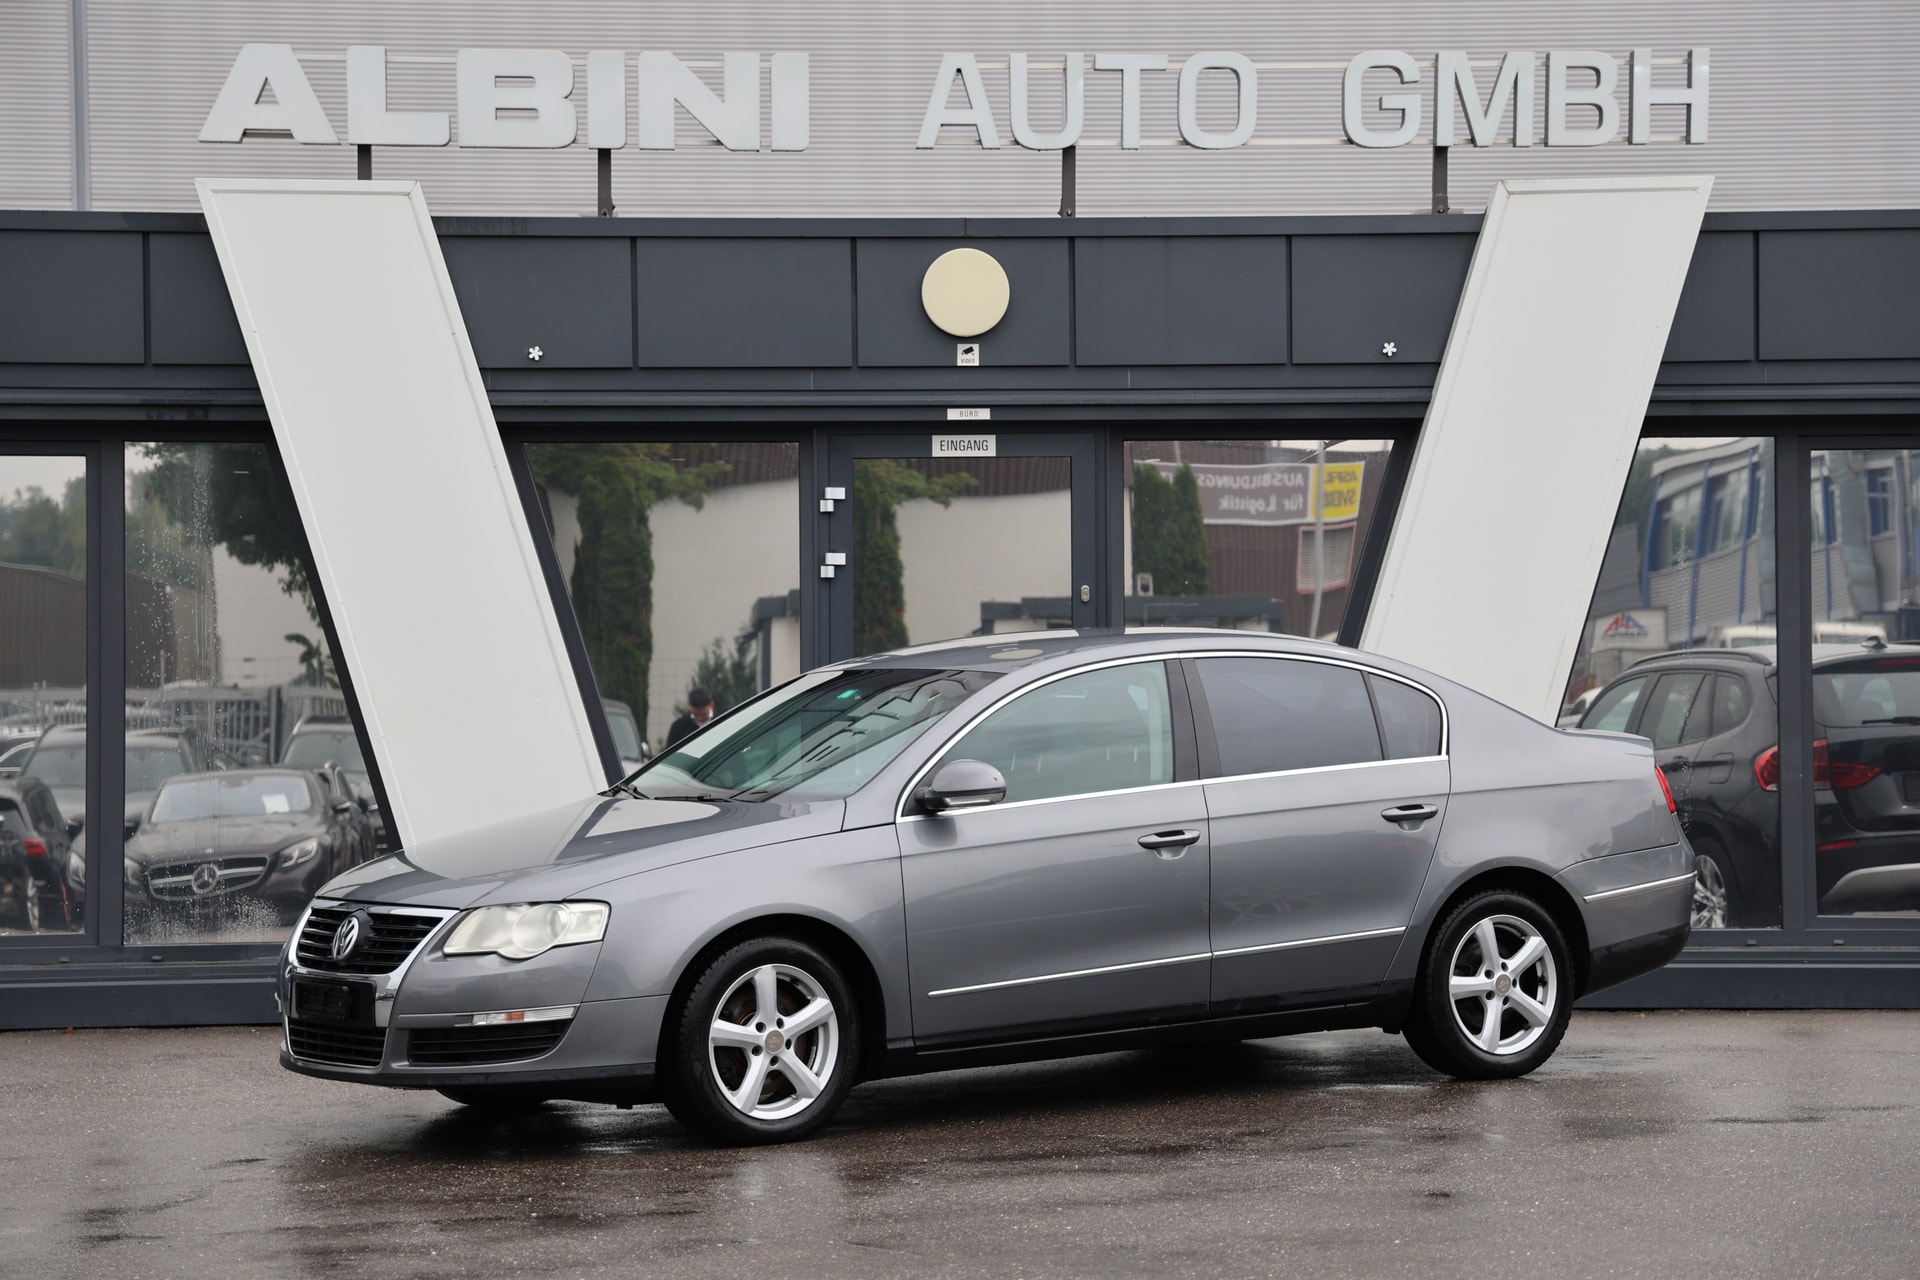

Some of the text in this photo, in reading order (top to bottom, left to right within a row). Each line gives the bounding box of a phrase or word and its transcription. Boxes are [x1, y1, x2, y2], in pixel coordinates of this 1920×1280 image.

[198, 43, 1711, 152] ALBINI AUTO GMBH
[959, 410, 979, 418] BÜRO
[939, 439, 989, 452] EINGANG
